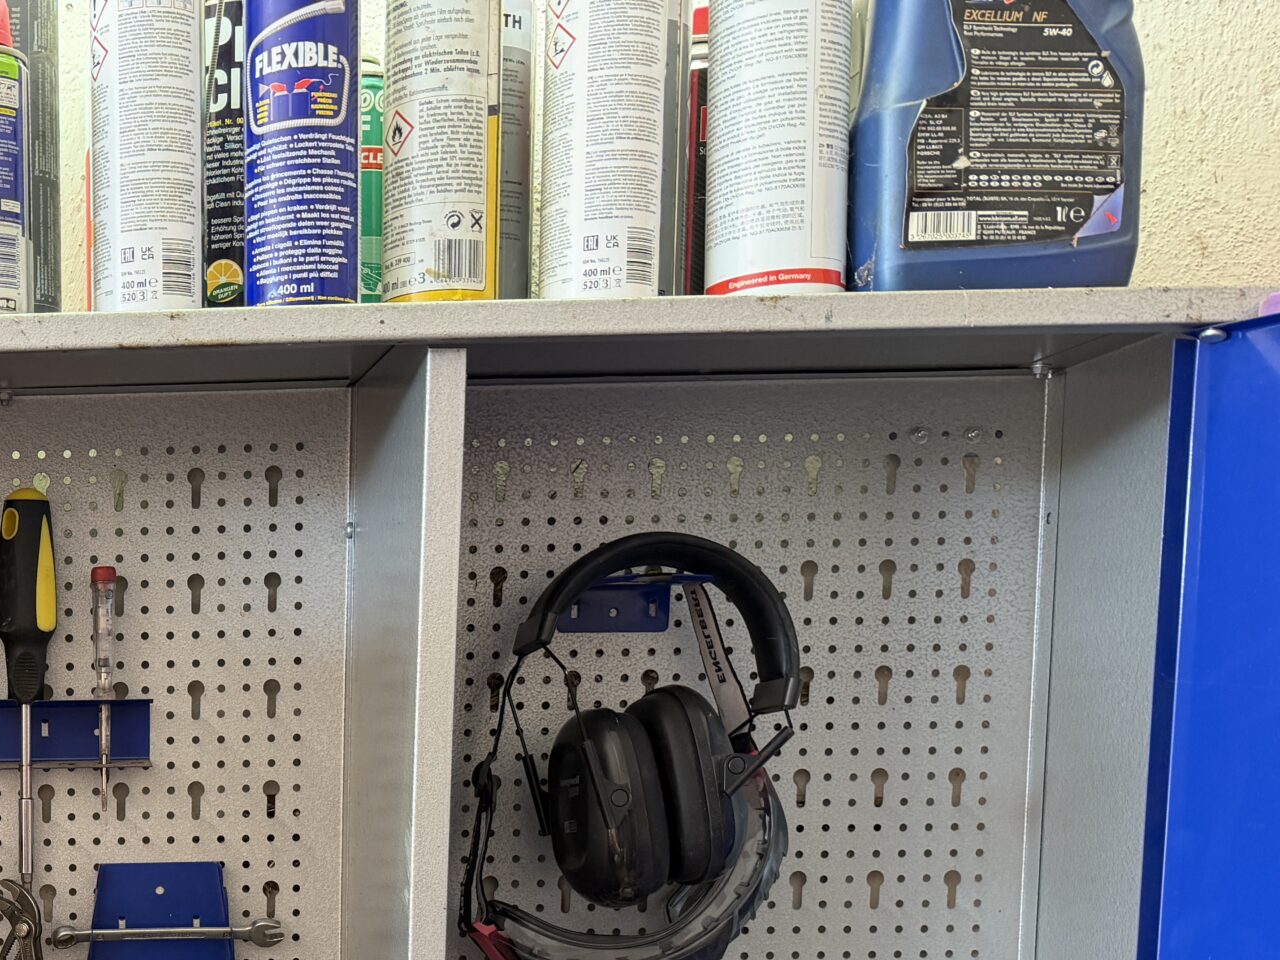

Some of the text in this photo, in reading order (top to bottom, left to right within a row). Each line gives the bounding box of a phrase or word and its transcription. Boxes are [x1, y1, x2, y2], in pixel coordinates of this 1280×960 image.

[963, 9, 1049, 22] EXCELLIUM NF
[1043, 28, 1073, 37] 5W-40
[308, 148, 336, 156] Mechanik
[287, 157, 321, 166] erreichbare
[322, 157, 341, 165] Stellen
[283, 177, 312, 186] Dégrippe
[286, 185, 324, 193] mécanismes
[287, 204, 308, 212] kraken
[289, 228, 322, 236] bereikbare
[605, 234, 619, 242] UK
[605, 241, 619, 249] CA
[140, 246, 154, 254] UK
[279, 248, 306, 257] protegge
[140, 253, 155, 261] CA
[305, 255, 320, 263] parti
[280, 263, 317, 272] meccanismi
[583, 266, 611, 277] 400 ml
[292, 271, 308, 280] punti
[308, 270, 319, 279] più
[121, 278, 147, 290] 400 ml
[583, 280, 599, 290] 520
[728, 272, 812, 290] Engineered in Germany
[277, 282, 315, 294] 400 ml
[122, 292, 136, 302] 520
